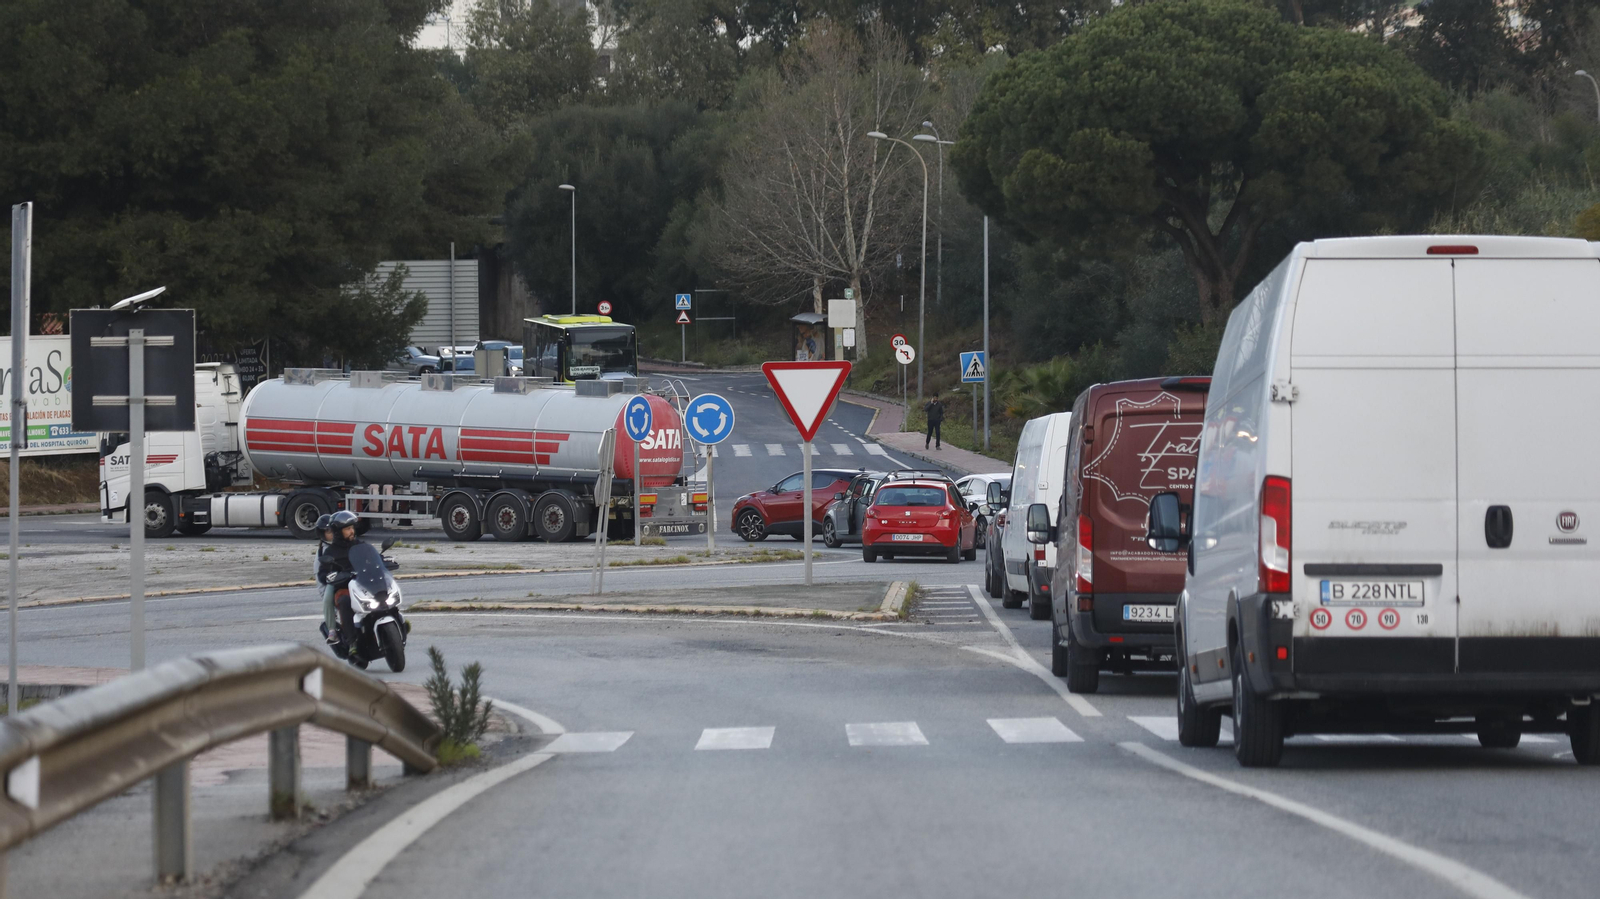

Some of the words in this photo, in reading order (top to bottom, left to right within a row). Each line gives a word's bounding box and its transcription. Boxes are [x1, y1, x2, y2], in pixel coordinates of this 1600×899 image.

[47, 410, 53, 419] DE
[54, 409, 71, 419] PLACAS
[59, 426, 70, 435] 633
[41, 439, 66, 447] HOSPITAL
[67, 438, 89, 446] QUIRÓN)
[362, 423, 448, 460] SATA
[640, 428, 681, 450] SATA
[110, 455, 131, 466] SAT
[1561, 515, 1576, 528] FIAT
[659, 525, 690, 534] FARCINOX
[1332, 583, 1344, 599] B
[1351, 583, 1381, 600] 228
[1384, 583, 1418, 600] NTL
[1131, 607, 1161, 618] 9234
[1316, 614, 1326, 624] 50
[1351, 614, 1361, 624] 70
[1384, 614, 1395, 624] 90
[1416, 614, 1429, 625] 130
